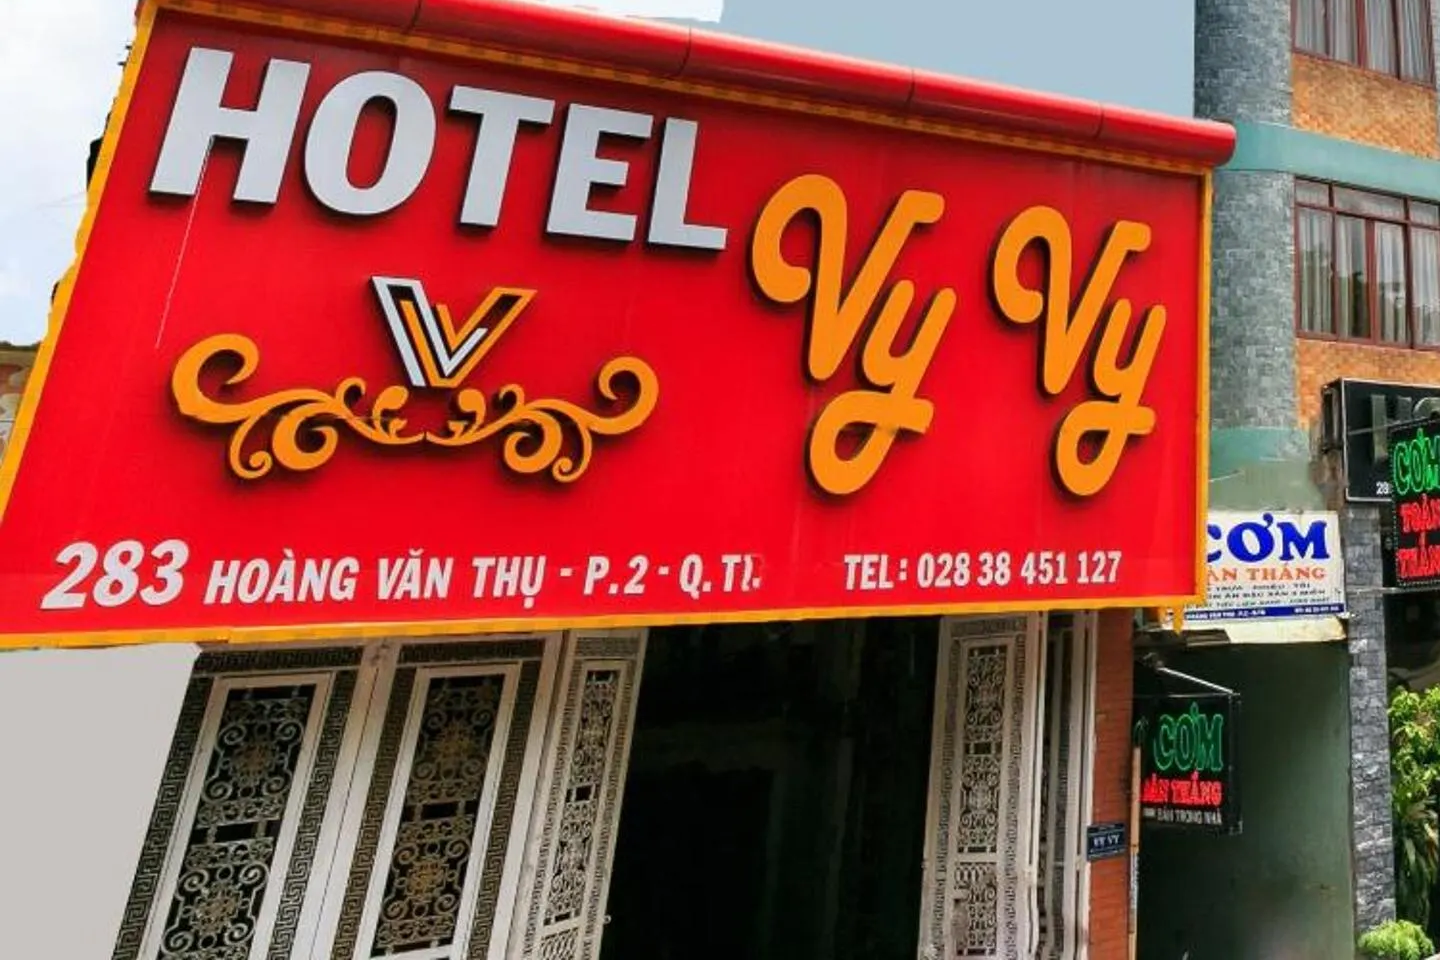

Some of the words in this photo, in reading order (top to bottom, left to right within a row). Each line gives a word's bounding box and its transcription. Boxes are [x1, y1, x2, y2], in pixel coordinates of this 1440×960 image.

[149, 46, 728, 250] HOTEL
[752, 173, 957, 495] Vy
[993, 205, 1167, 497] Vy
[40, 539, 190, 610] 283
[203, 548, 360, 605] HOÀNG
[376, 548, 454, 600] VĂN
[470, 554, 548, 609] THỤ
[843, 553, 909, 590] TEL:
[917, 552, 971, 589] 028
[977, 551, 1012, 587] 38
[1020, 550, 1069, 586] 451
[1076, 550, 1123, 585] 127
[1154, 701, 1224, 771] CƠM
